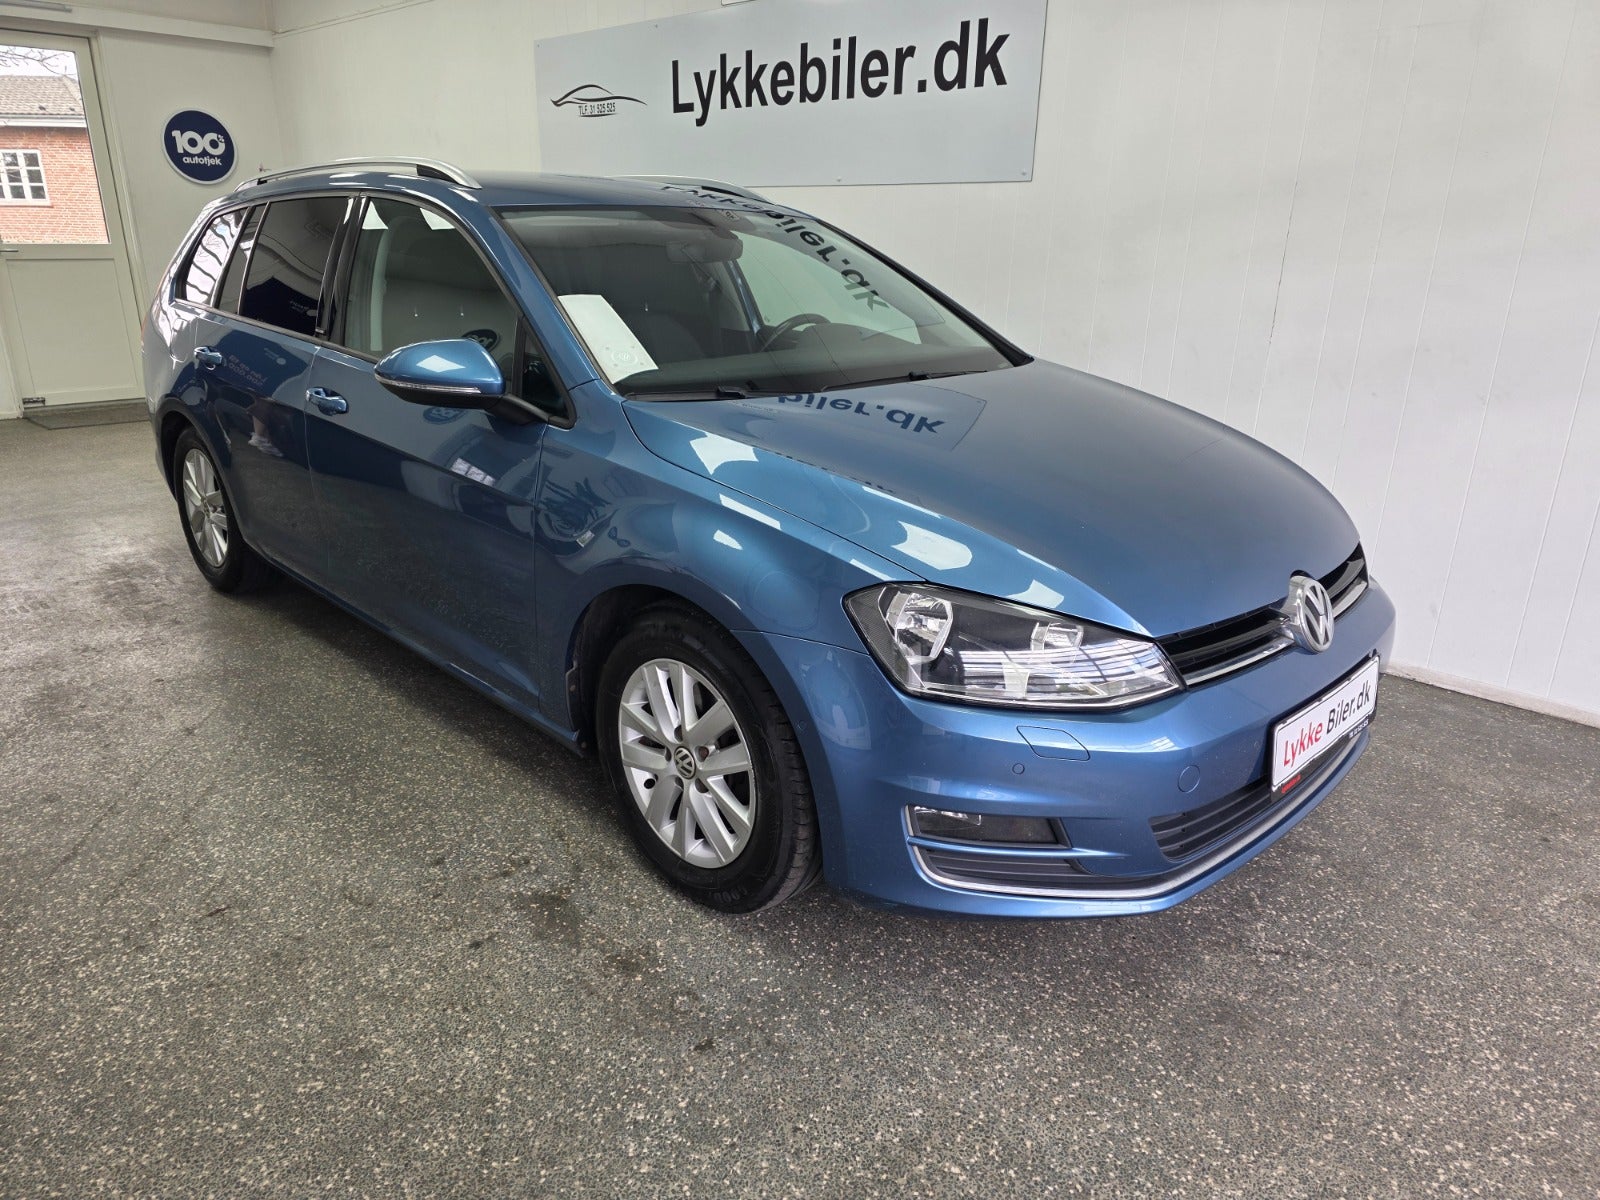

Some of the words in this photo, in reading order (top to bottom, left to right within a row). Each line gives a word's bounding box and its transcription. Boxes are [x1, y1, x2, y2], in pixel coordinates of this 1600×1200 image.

[672, 18, 1009, 127] Lykkebiler.dk
[607, 102, 616, 112] 525
[183, 156, 222, 166] autotjek
[1284, 722, 1323, 767] Lykke
[1327, 680, 1371, 734] Biler.dk
